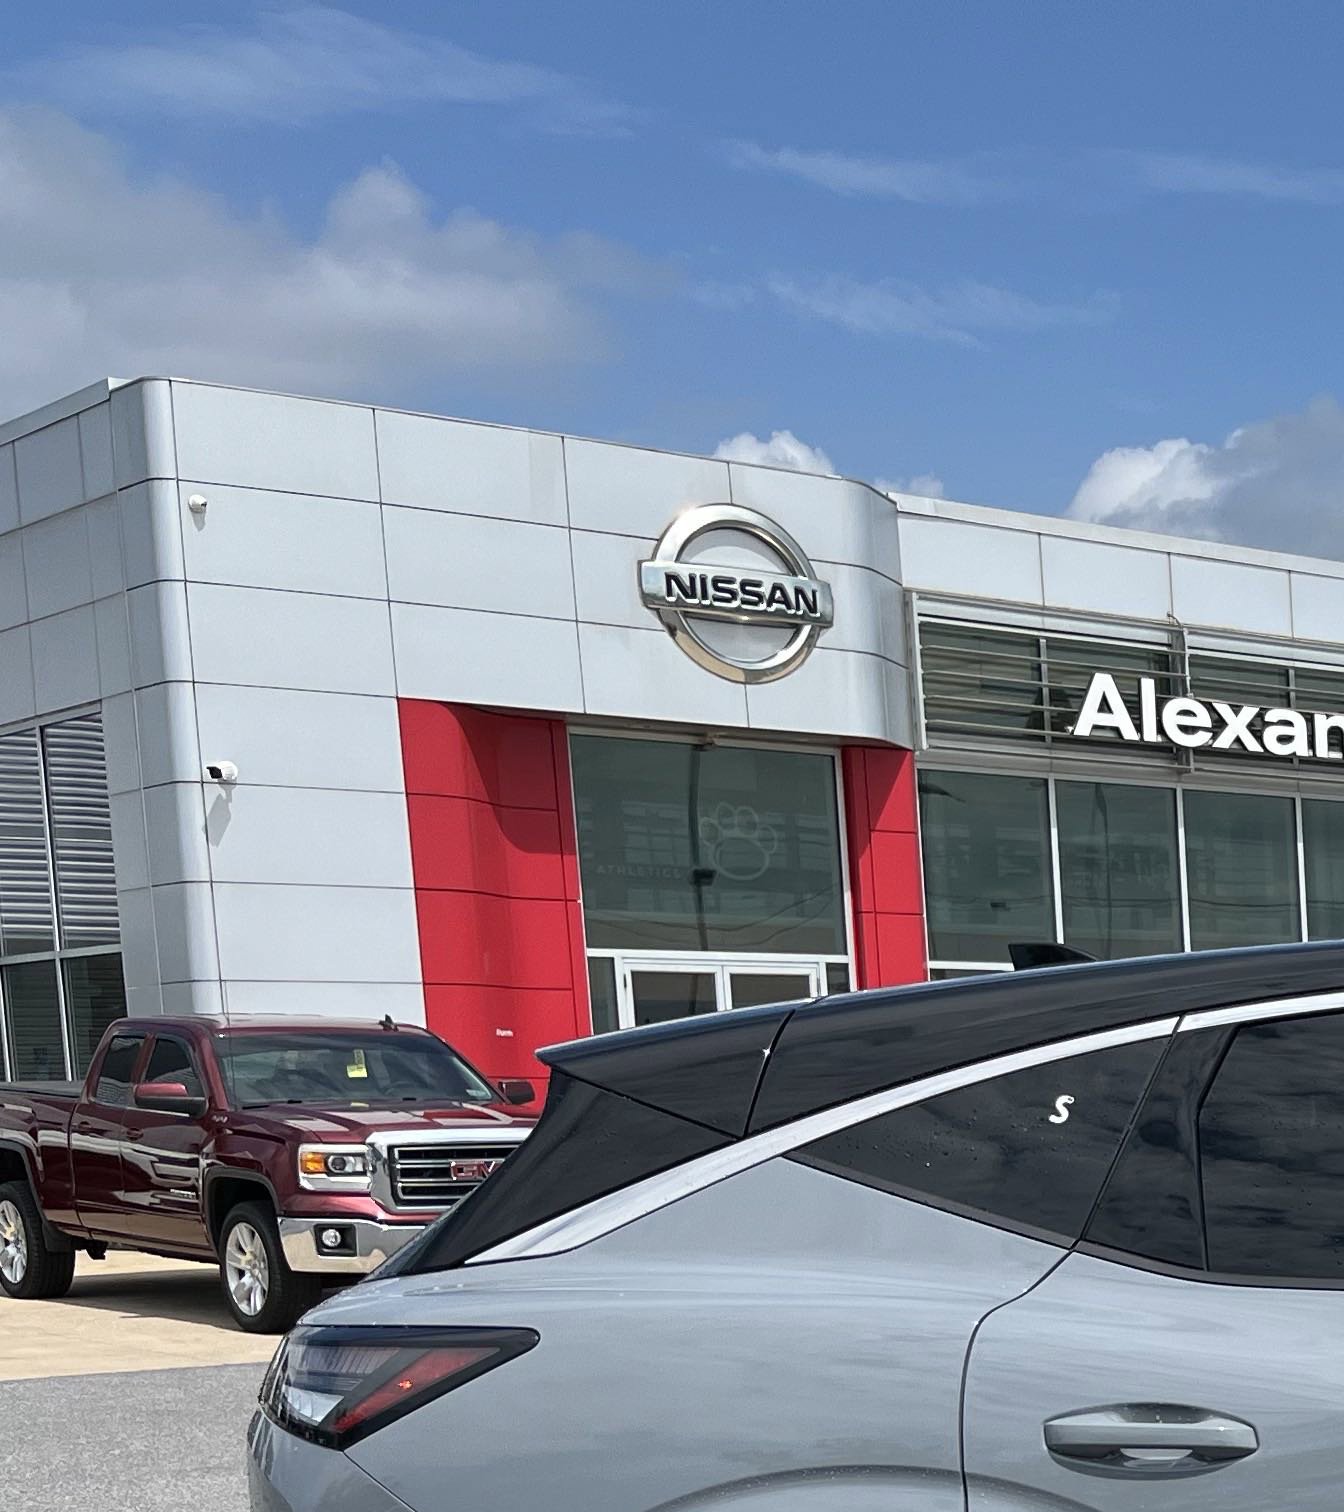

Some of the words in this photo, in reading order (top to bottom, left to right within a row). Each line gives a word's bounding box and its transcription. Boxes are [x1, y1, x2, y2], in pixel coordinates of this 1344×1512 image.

[664, 571, 820, 617] NISSAN
[1049, 1095, 1075, 1124] S
[450, 1160, 503, 1181] GM
